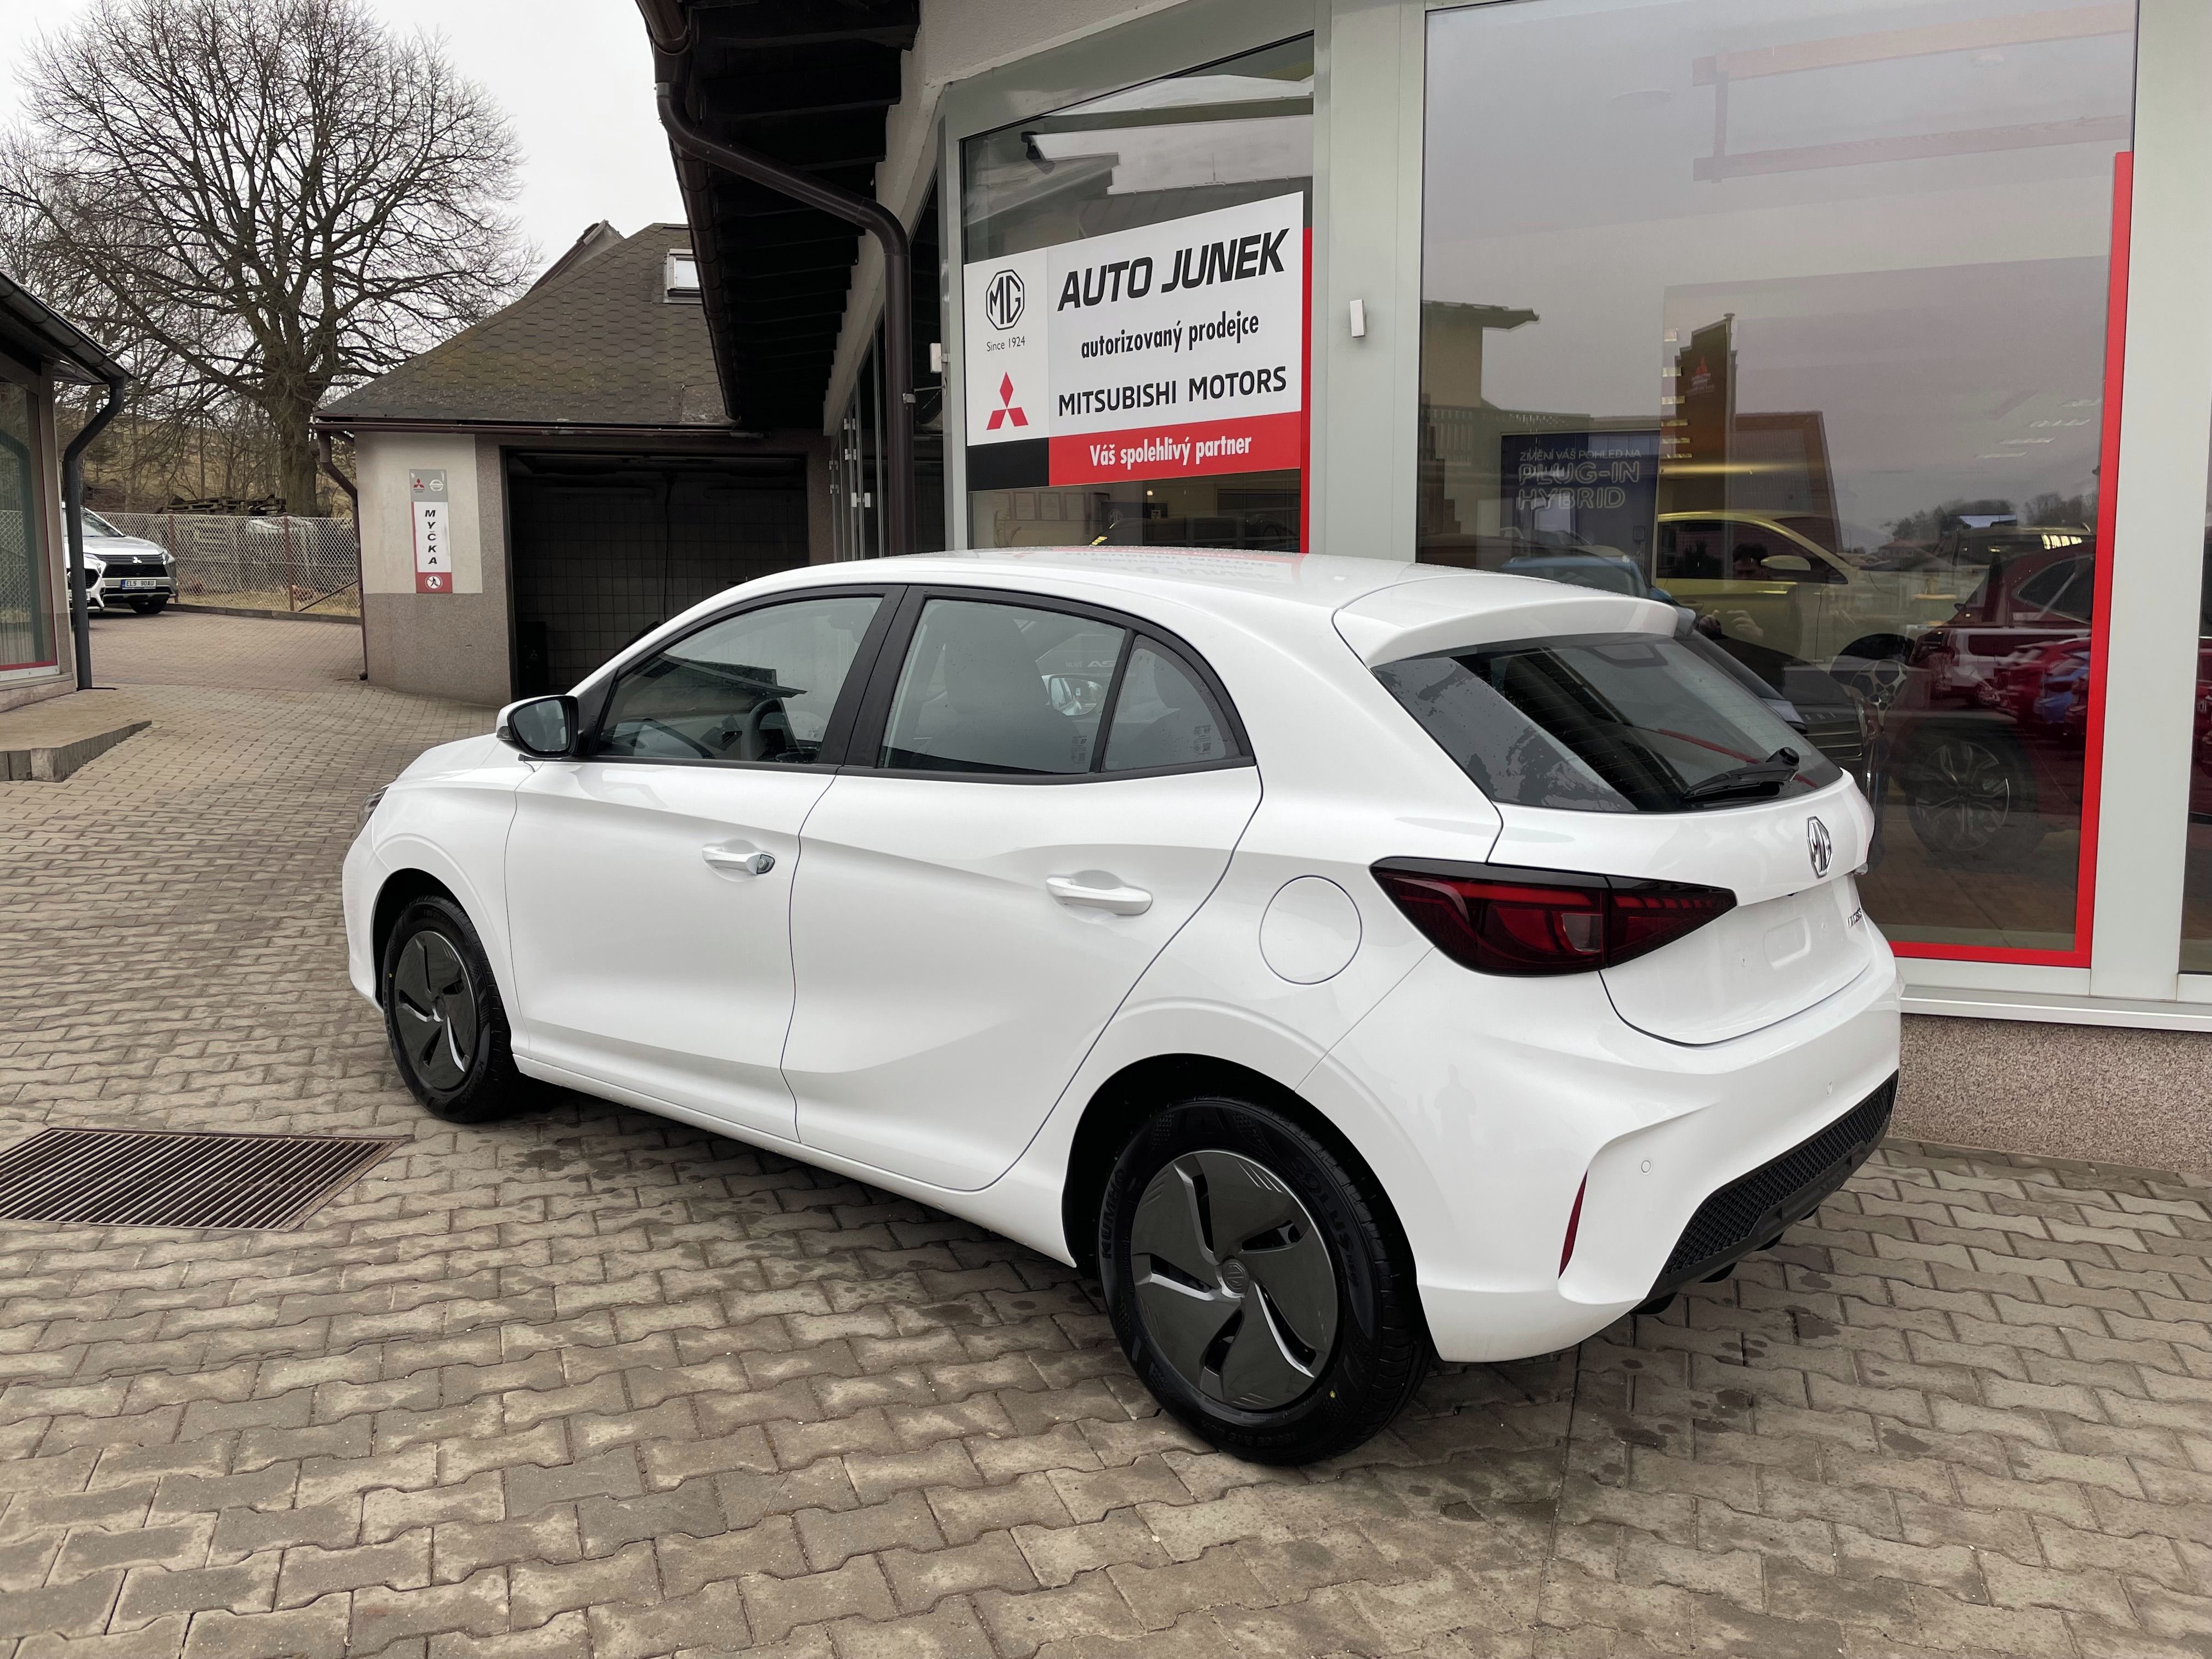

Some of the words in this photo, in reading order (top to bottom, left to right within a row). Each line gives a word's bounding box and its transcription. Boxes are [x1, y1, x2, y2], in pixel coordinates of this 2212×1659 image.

[1057, 256, 1153, 312] AUTO
[1160, 228, 1290, 294] JUNEK
[988, 272, 1023, 328] MG
[986, 340, 1005, 352] Since
[1008, 336, 1025, 349] 1924
[1081, 320, 1181, 358] autorizovaný
[1189, 311, 1259, 351] prodejce
[1059, 380, 1176, 416] MITSUBISHI
[1189, 366, 1286, 402] MOTORS
[1090, 443, 1116, 467] Váš
[1120, 437, 1190, 470] spolehlivý
[1195, 436, 1252, 463] partner
[1556, 448, 1576, 460] VÁŠ
[1578, 449, 1623, 460] POHLED
[1626, 449, 1641, 458] NA
[1519, 461, 1640, 486] PLUG-IN
[1518, 487, 1625, 510] HYBRID
[424, 509, 438, 565] MYČKA
